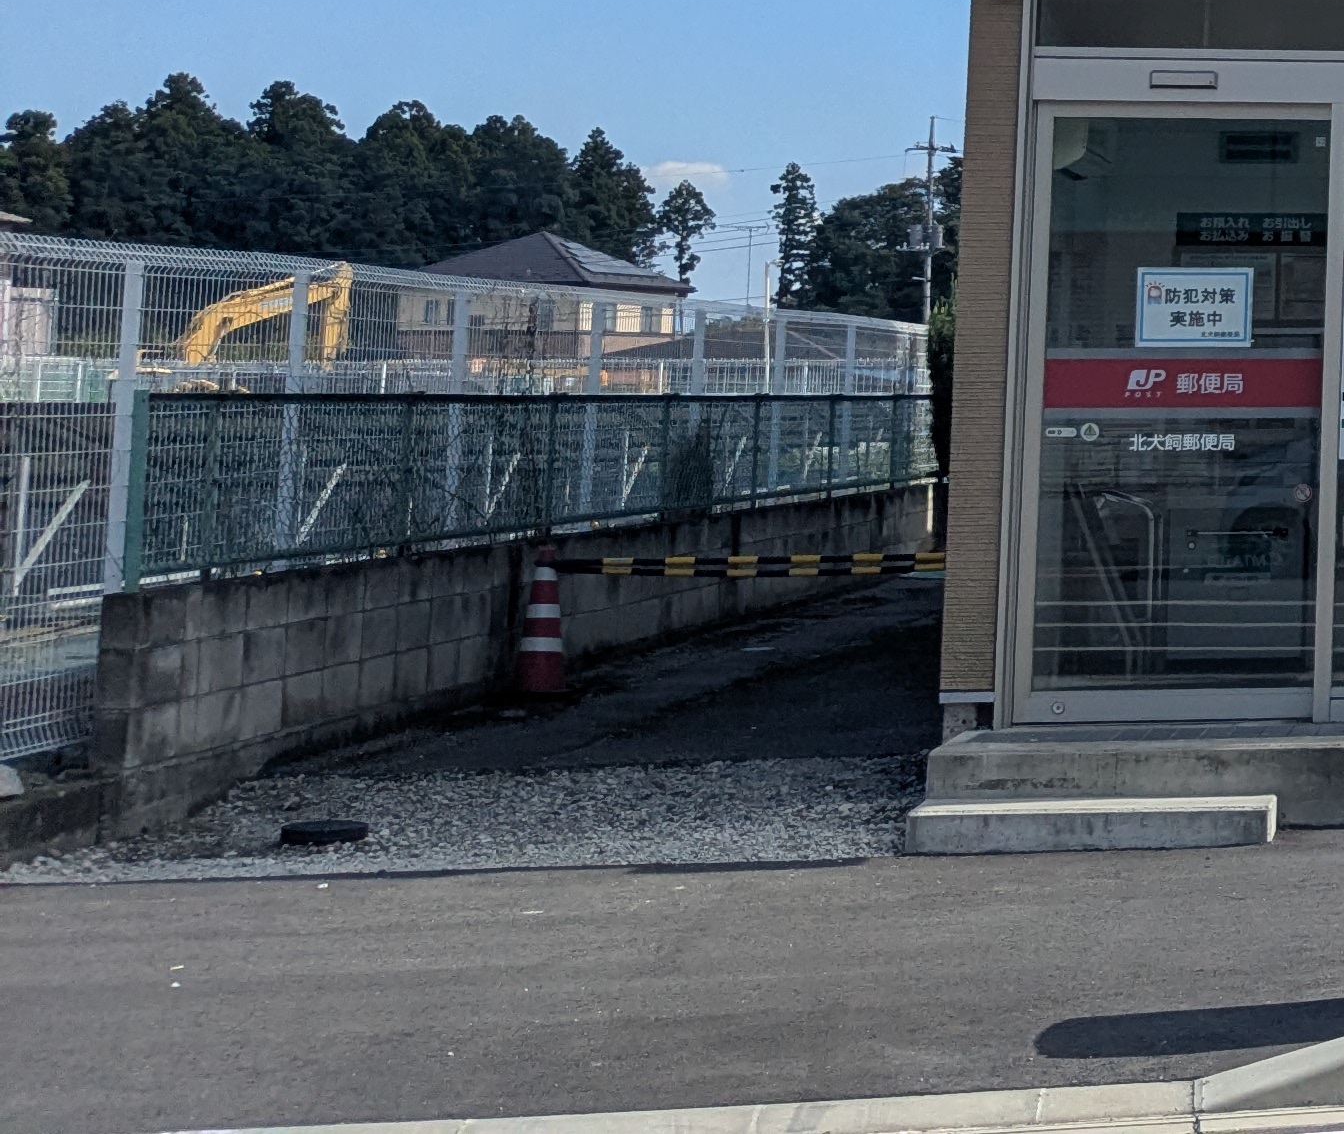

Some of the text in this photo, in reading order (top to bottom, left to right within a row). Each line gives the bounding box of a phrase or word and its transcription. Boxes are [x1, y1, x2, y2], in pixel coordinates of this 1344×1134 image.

[1164, 287, 1236, 305] 防犯対策
[1169, 310, 1223, 328] 実施中
[1176, 373, 1244, 394] 郵便局
[1129, 433, 1236, 451] 北犬飼郵便局
